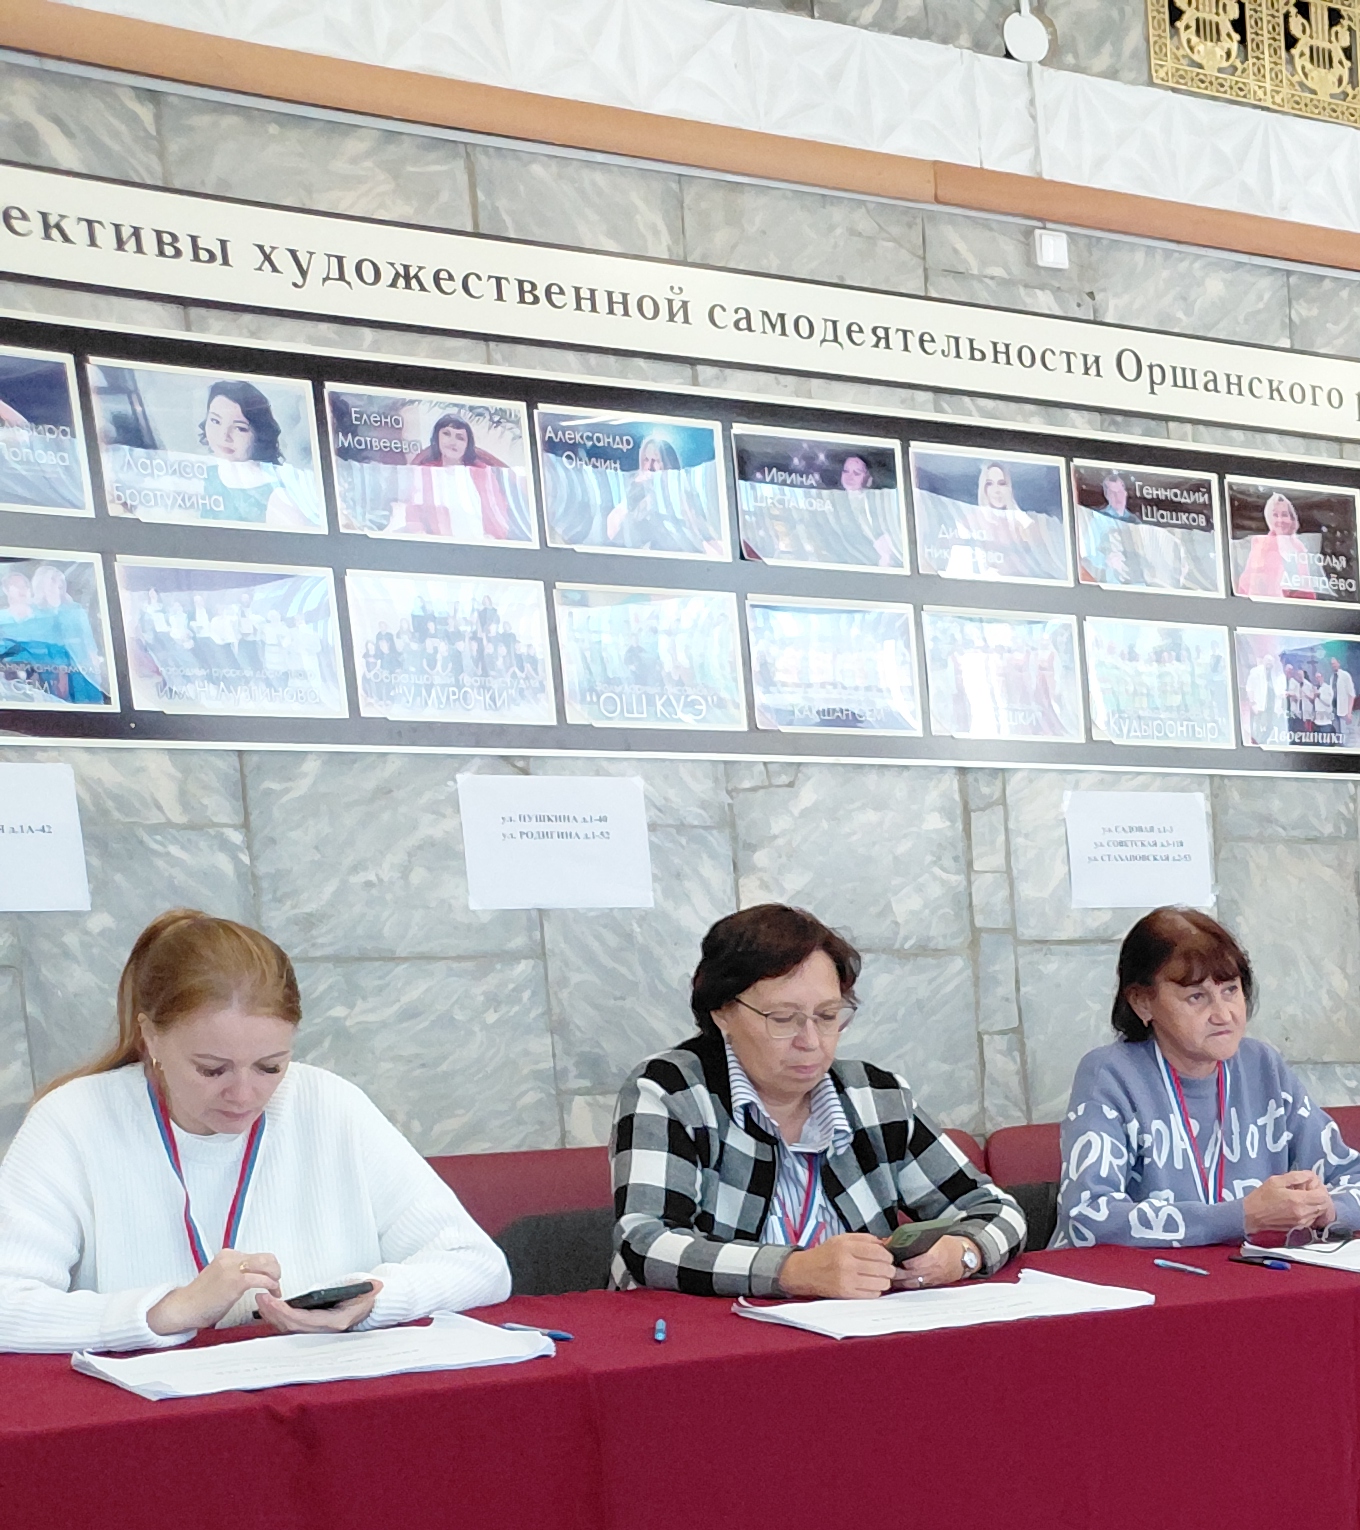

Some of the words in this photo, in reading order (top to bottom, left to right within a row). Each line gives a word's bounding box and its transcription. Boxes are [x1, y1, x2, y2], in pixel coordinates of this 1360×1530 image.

[2, 203, 234, 268] ективы
[252, 241, 693, 325] художественной
[707, 302, 1104, 379] самодеятельности
[1115, 347, 1344, 409] Оршанского
[351, 408, 404, 429] Елена
[338, 433, 421, 453] Матвеева
[545, 425, 634, 452] Александр
[122, 455, 209, 481] Лариса
[112, 484, 225, 513] Братухина
[1134, 481, 1209, 506] Геннадий
[1142, 504, 1206, 527] Шашков
[586, 691, 648, 718] "ОШ
[518, 813, 578, 824] ПУШКИНА
[519, 830, 580, 840] РОДИГИНА
[1106, 839, 1158, 848] СОВЕТСКАЯ
[1100, 854, 1170, 862] СТАХАНОВСКАЯ
